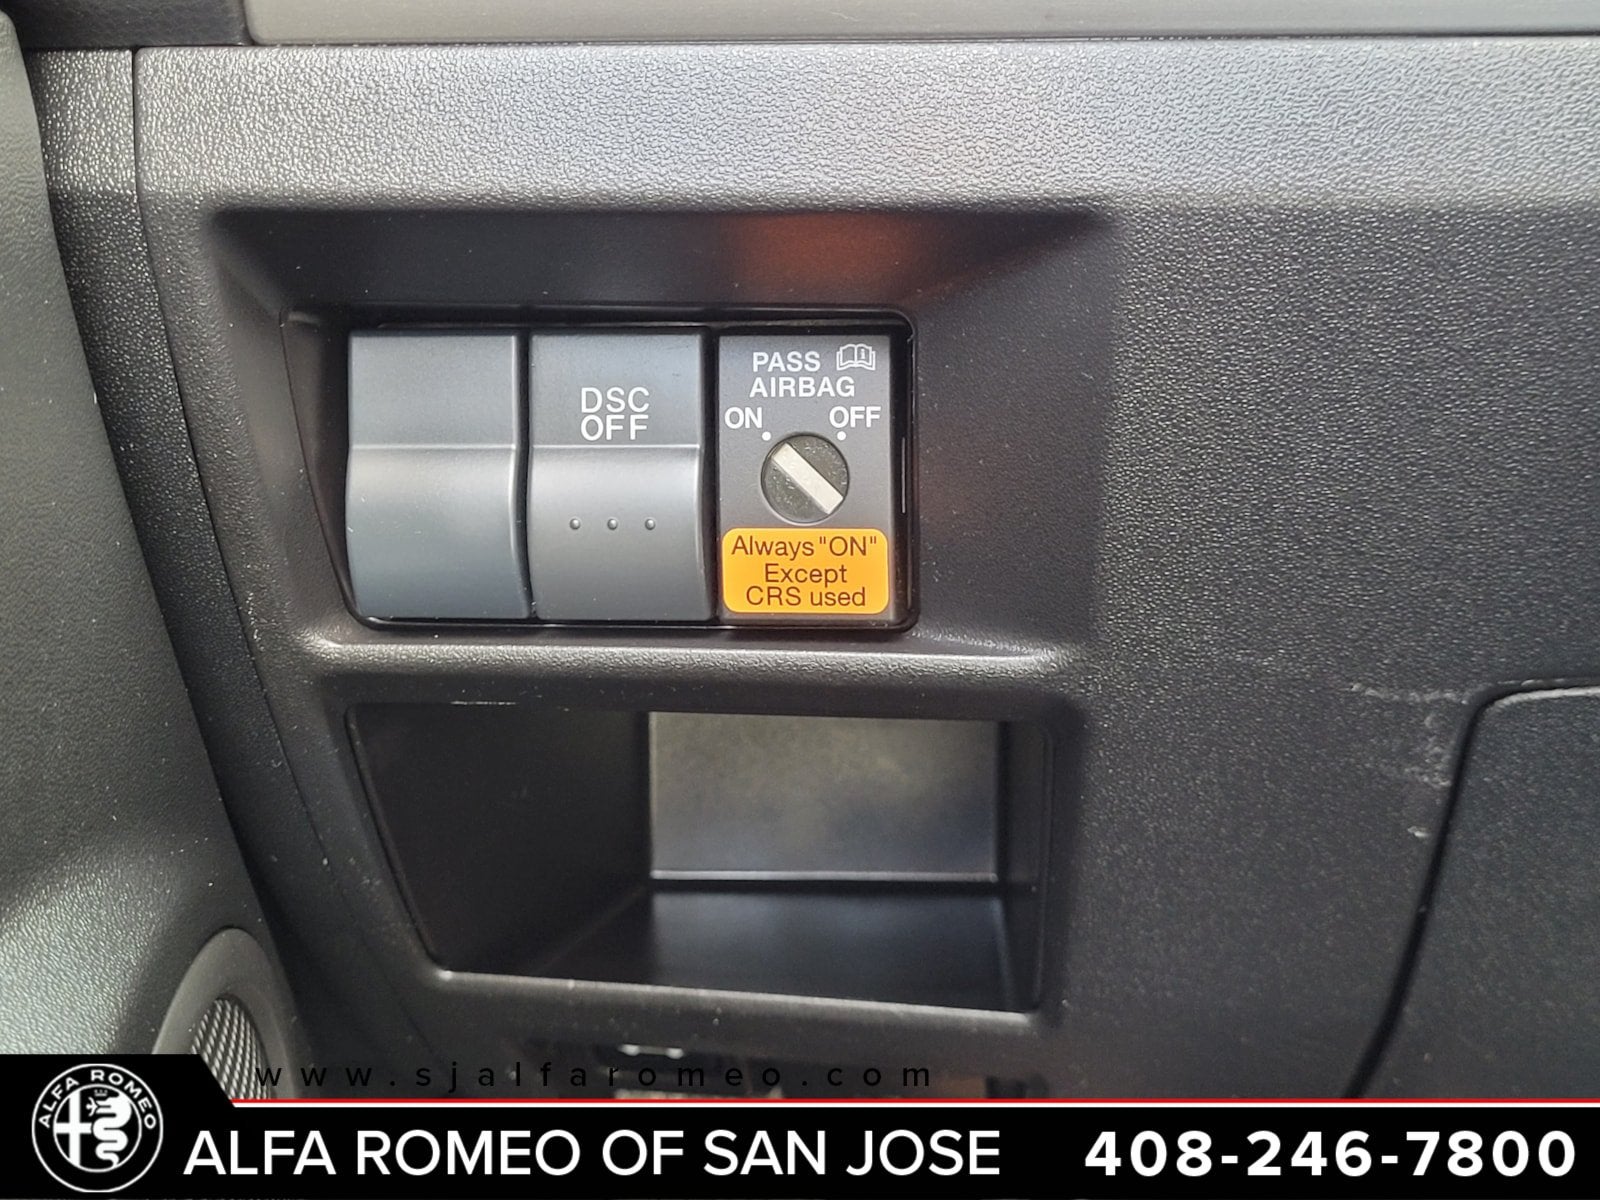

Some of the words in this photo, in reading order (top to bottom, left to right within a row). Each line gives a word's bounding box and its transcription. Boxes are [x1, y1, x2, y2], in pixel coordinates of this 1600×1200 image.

[752, 352, 821, 373] PASS
[749, 376, 855, 398] AIRBAG
[581, 387, 650, 413] DSC
[581, 414, 649, 441] OFF
[724, 407, 763, 429] ON
[829, 406, 881, 428] OFF
[731, 535, 815, 561] Always
[819, 536, 877, 556] "ON"
[764, 563, 848, 588] Except
[746, 586, 801, 606] CRS
[810, 587, 866, 606] used
